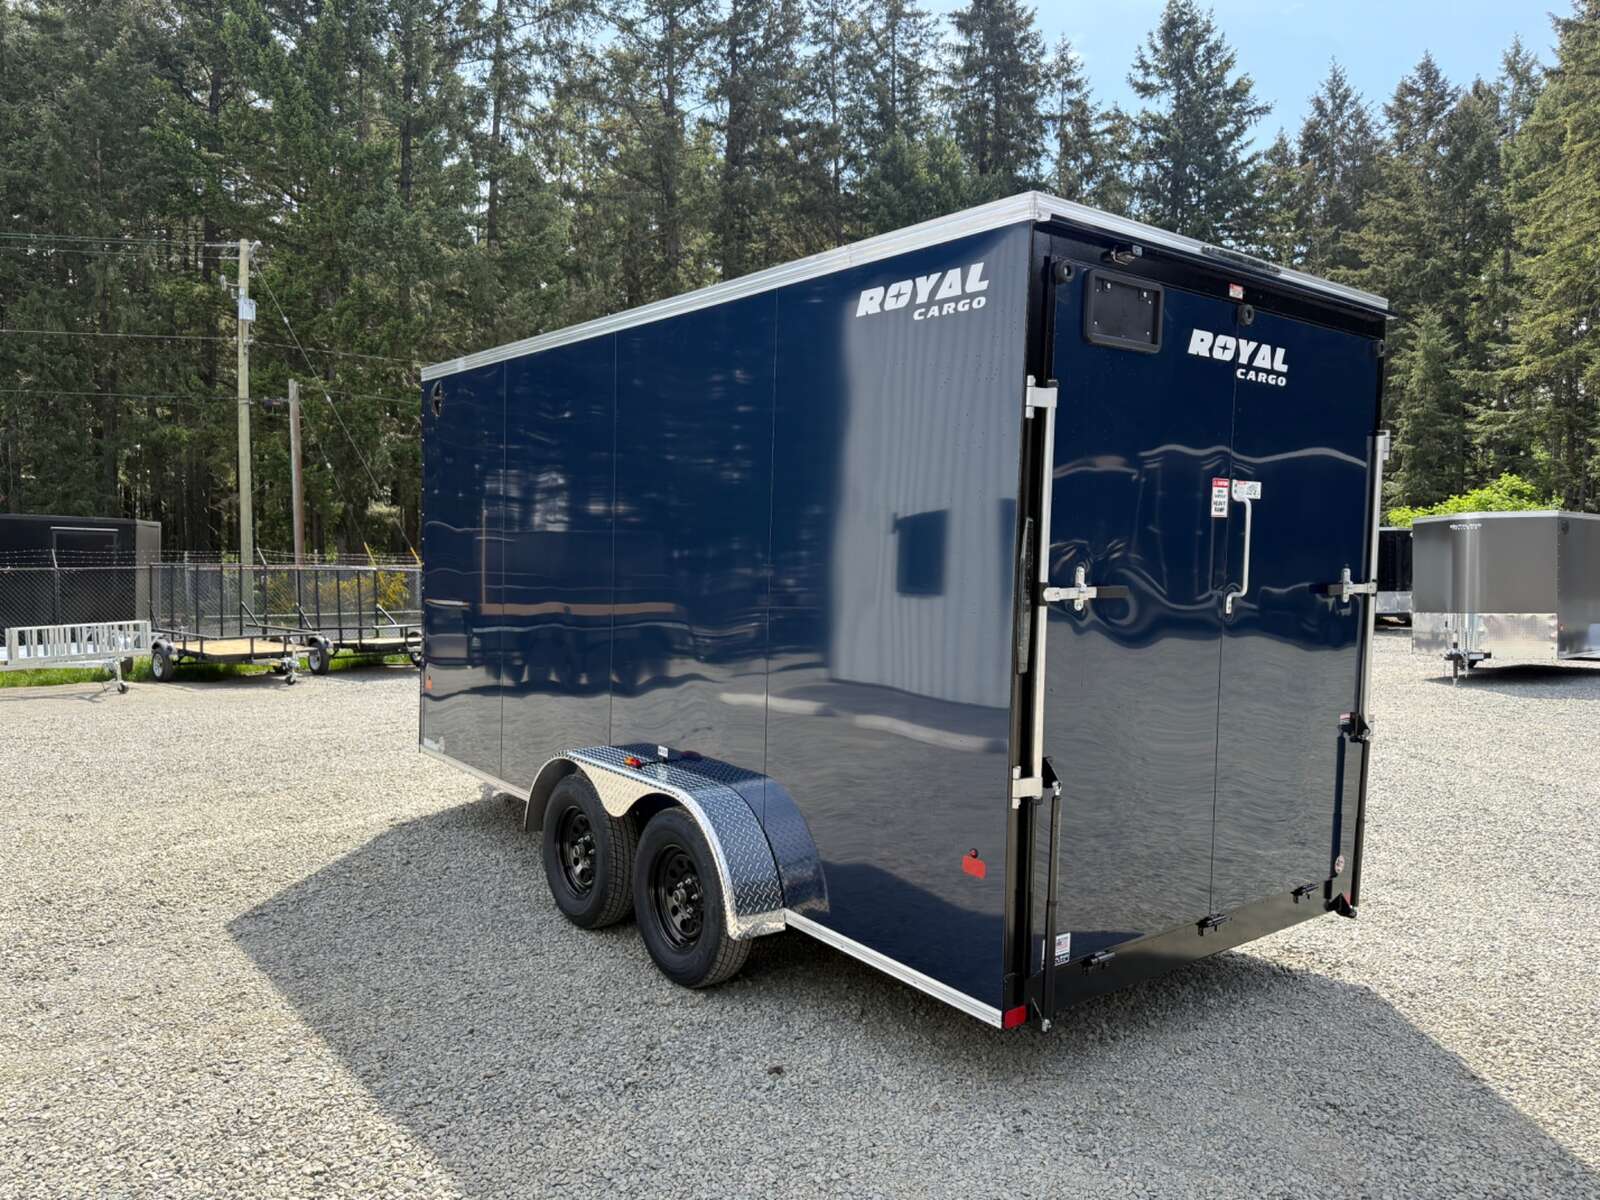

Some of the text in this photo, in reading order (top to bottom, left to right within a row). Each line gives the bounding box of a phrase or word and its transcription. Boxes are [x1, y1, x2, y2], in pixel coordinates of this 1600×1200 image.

[856, 262, 989, 317] ROYAL
[913, 297, 986, 320] CARGO
[1187, 328, 1289, 373] ROYAL
[1236, 368, 1287, 387] CARGO
